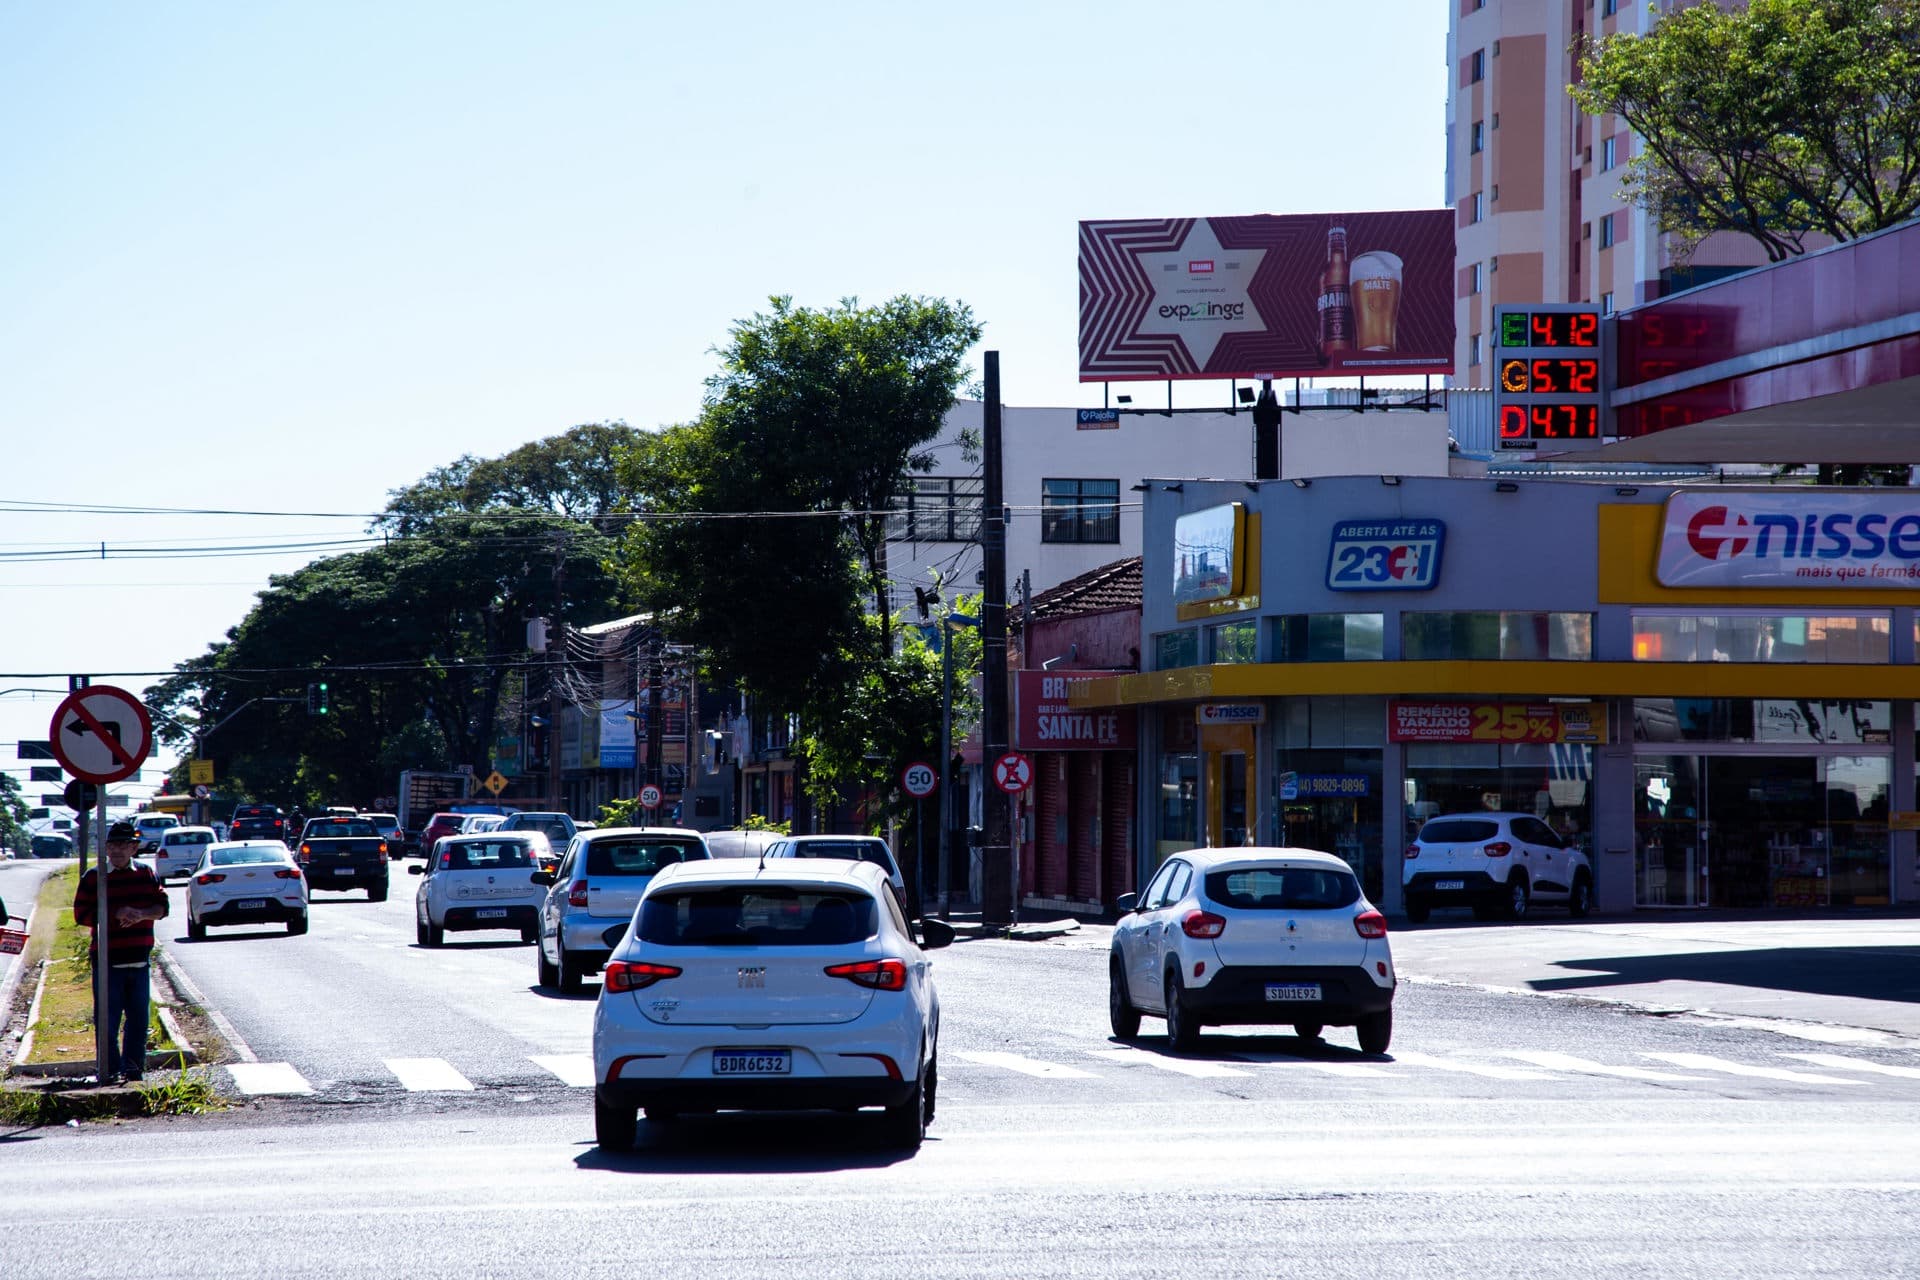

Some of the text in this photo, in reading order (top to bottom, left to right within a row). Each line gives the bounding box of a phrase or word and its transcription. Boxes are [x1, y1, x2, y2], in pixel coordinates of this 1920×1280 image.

[1363, 280, 1391, 290] MALTE
[1503, 314, 1597, 346] E 4.12
[1501, 360, 1597, 392] G 5.72
[1500, 405, 1597, 438] D 4.71
[1339, 526, 1388, 537] ABERTA
[1796, 562, 1833, 577] mais
[1837, 565, 1867, 581] que
[1219, 706, 1260, 718] nissei
[1397, 704, 1470, 717] REMÉDIO
[1038, 715, 1094, 739] SANTA
[1397, 717, 1470, 727] TARJADO
[1472, 706, 1553, 738] 25%
[1419, 727, 1470, 736] CONTÍNUO
[909, 771, 931, 785] 50
[643, 791, 658, 801] 50
[1271, 988, 1317, 999] SDU1E92
[720, 1057, 783, 1071] BDR6C32
